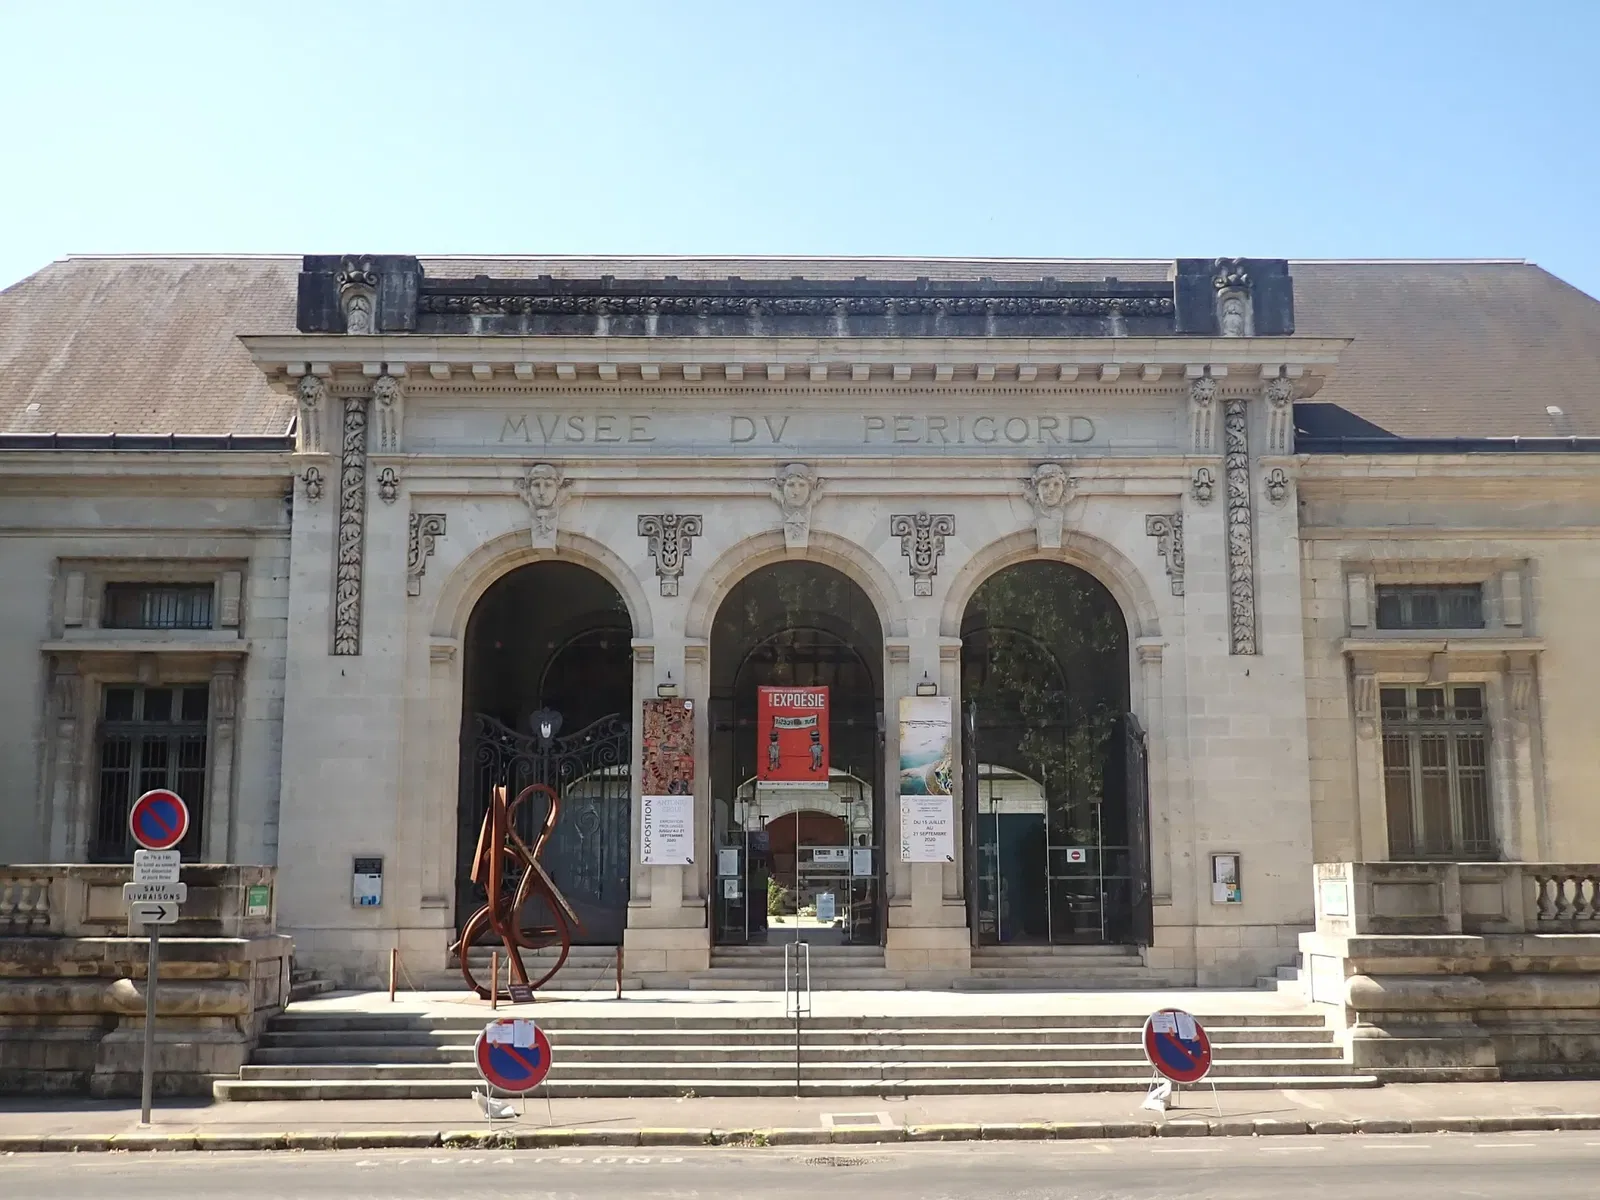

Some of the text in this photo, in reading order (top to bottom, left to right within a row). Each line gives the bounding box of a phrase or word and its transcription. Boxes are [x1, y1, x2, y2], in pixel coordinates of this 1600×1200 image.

[498, 414, 1097, 444] MVSEE DV PERIGORD
[773, 691, 825, 707] EXPOÉSIE
[644, 799, 652, 854] EXPOSITION
